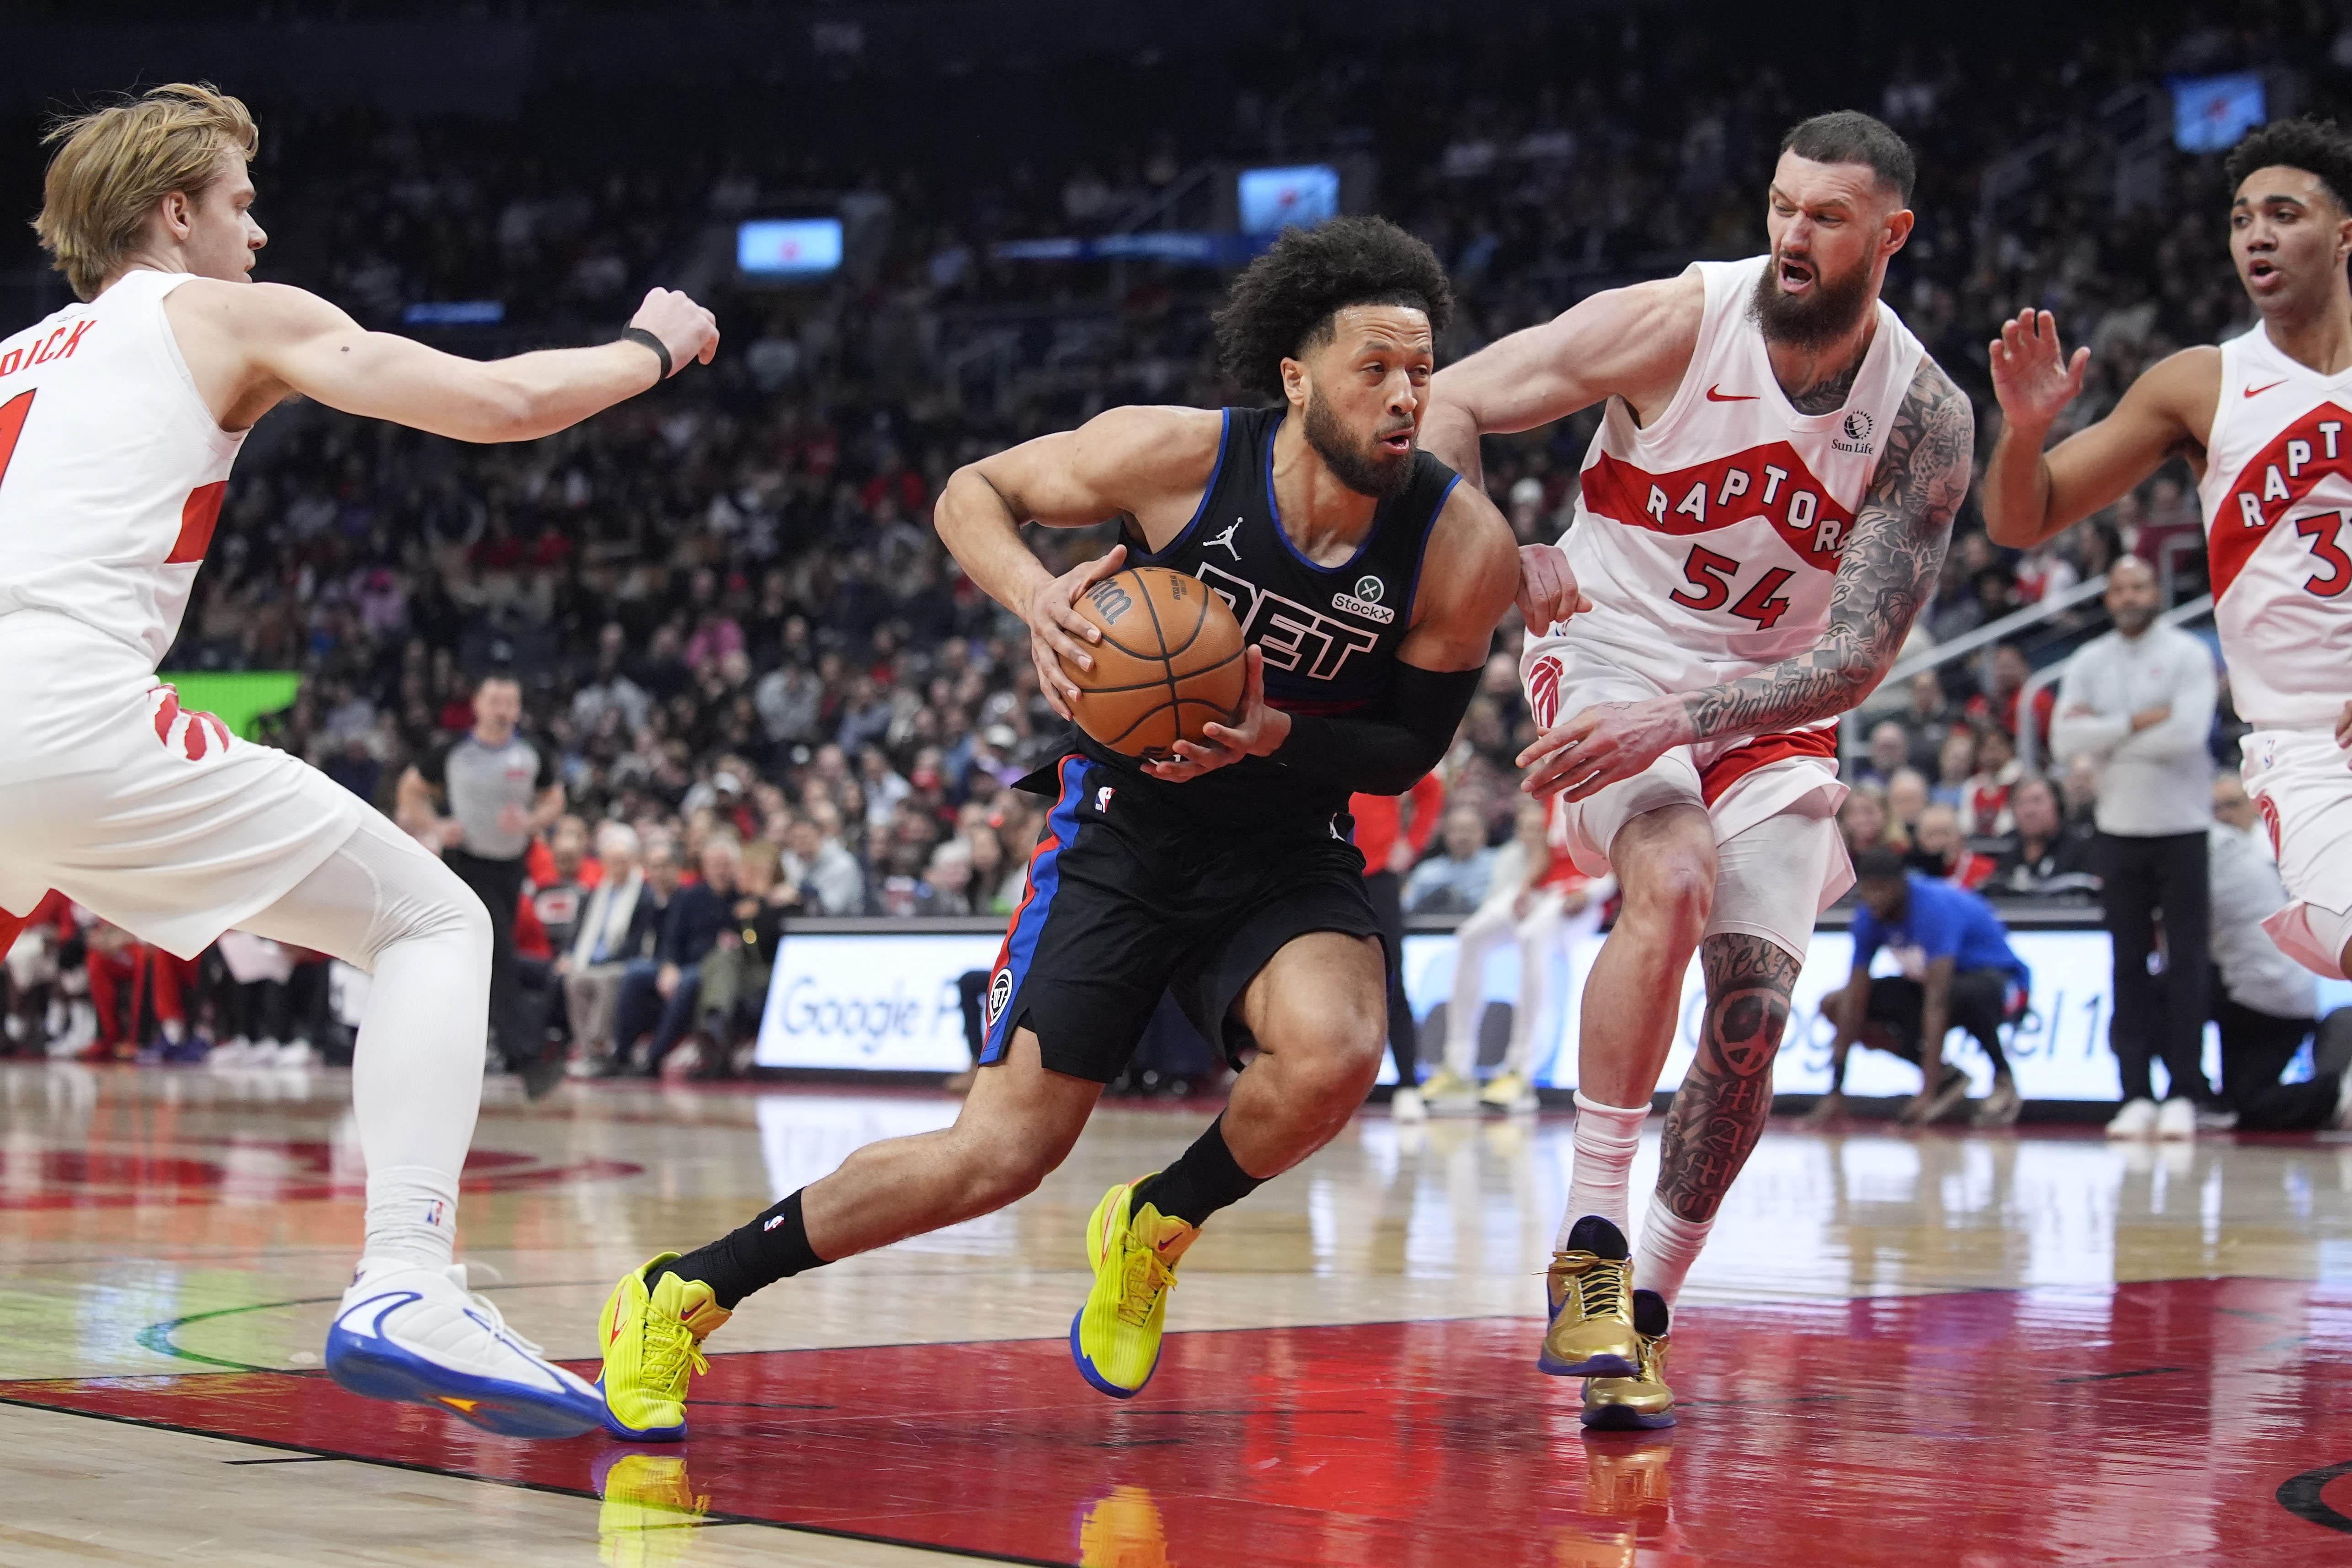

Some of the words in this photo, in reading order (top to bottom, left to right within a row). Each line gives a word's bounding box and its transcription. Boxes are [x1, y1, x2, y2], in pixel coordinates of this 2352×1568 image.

[0, 320, 98, 378] DICK
[1831, 439, 1852, 452] Sun
[1854, 443, 1873, 454] Life
[2237, 421, 2352, 528] RAPT
[1669, 544, 1797, 631] 54
[2295, 511, 2352, 597] 3
[1085, 577, 1133, 626] Wil
[1335, 596, 1392, 622] StockX
[784, 976, 919, 1054] Google
